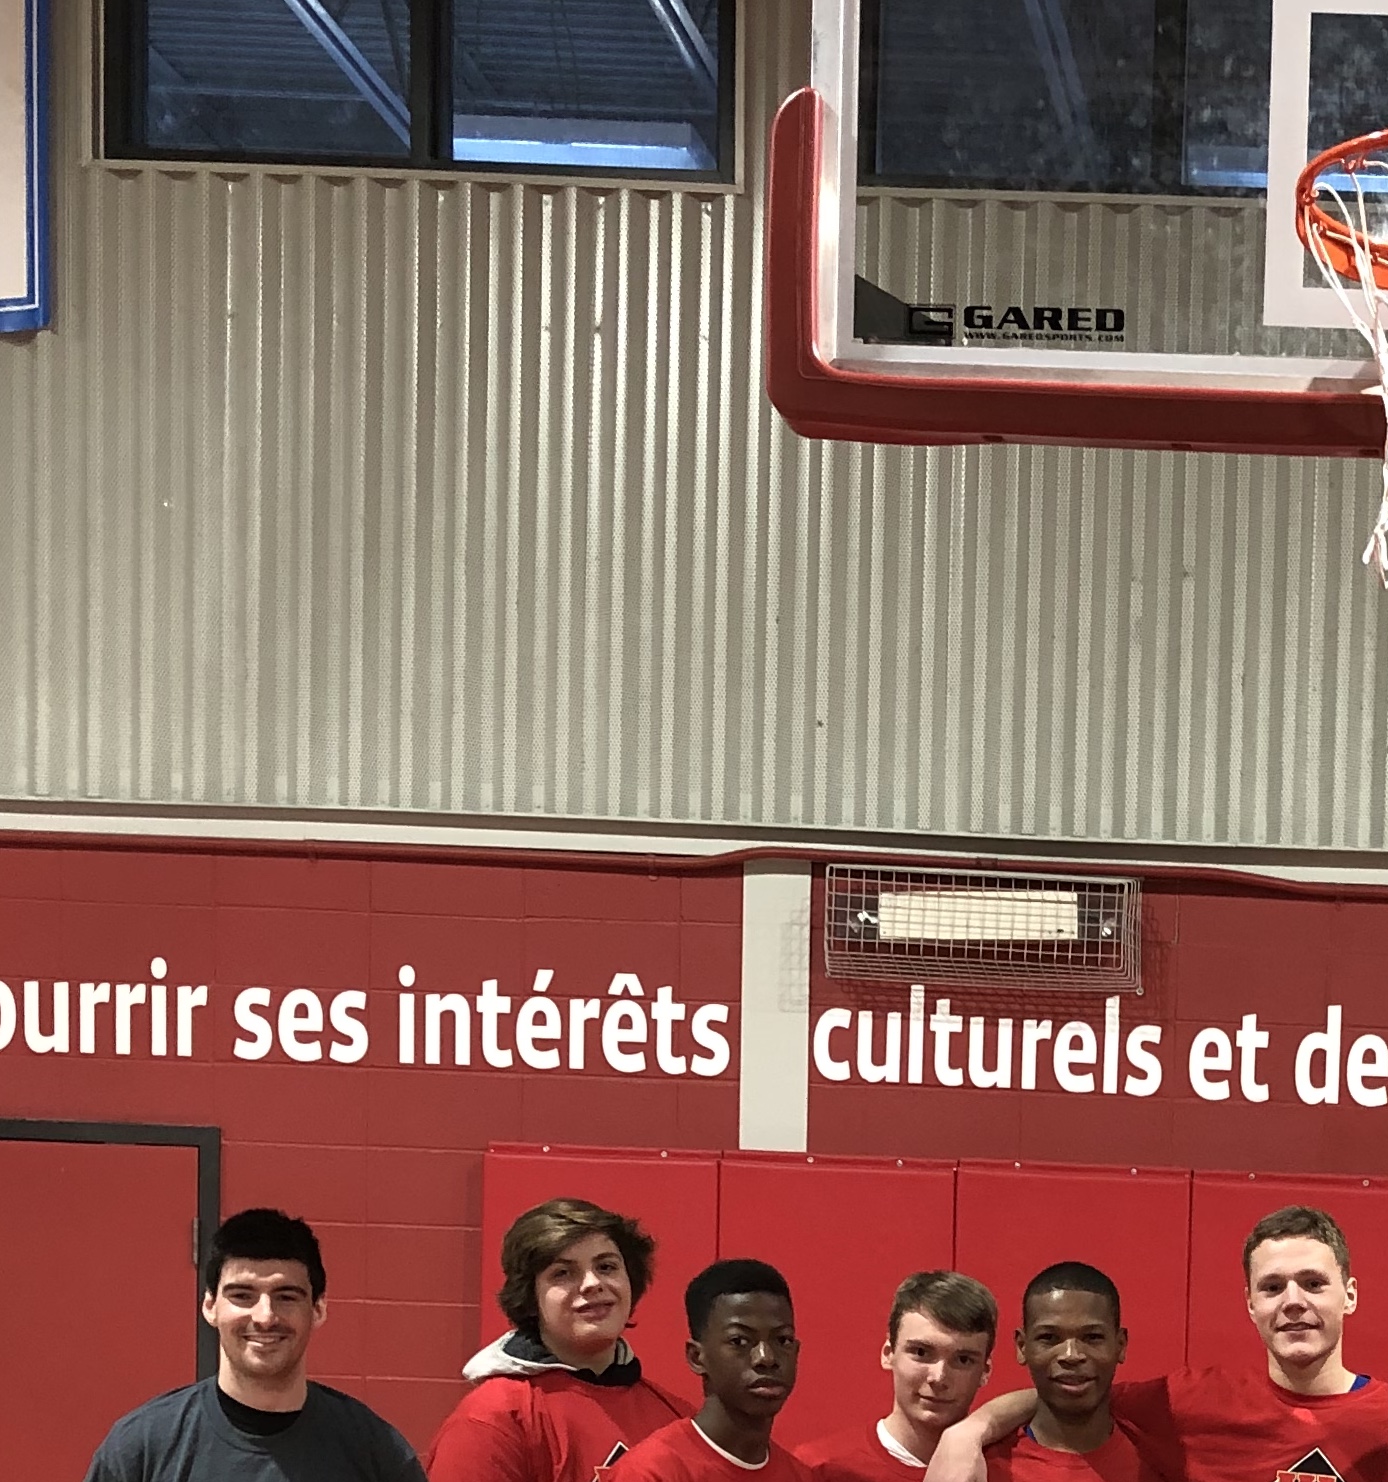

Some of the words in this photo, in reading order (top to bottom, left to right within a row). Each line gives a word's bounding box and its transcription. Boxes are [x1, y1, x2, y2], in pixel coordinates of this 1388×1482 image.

[963, 306, 1125, 332] GARED
[232, 986, 368, 1063] ses
[398, 964, 731, 1078] intérêts
[813, 984, 1162, 1097] culturels
[1188, 1013, 1270, 1103] et
